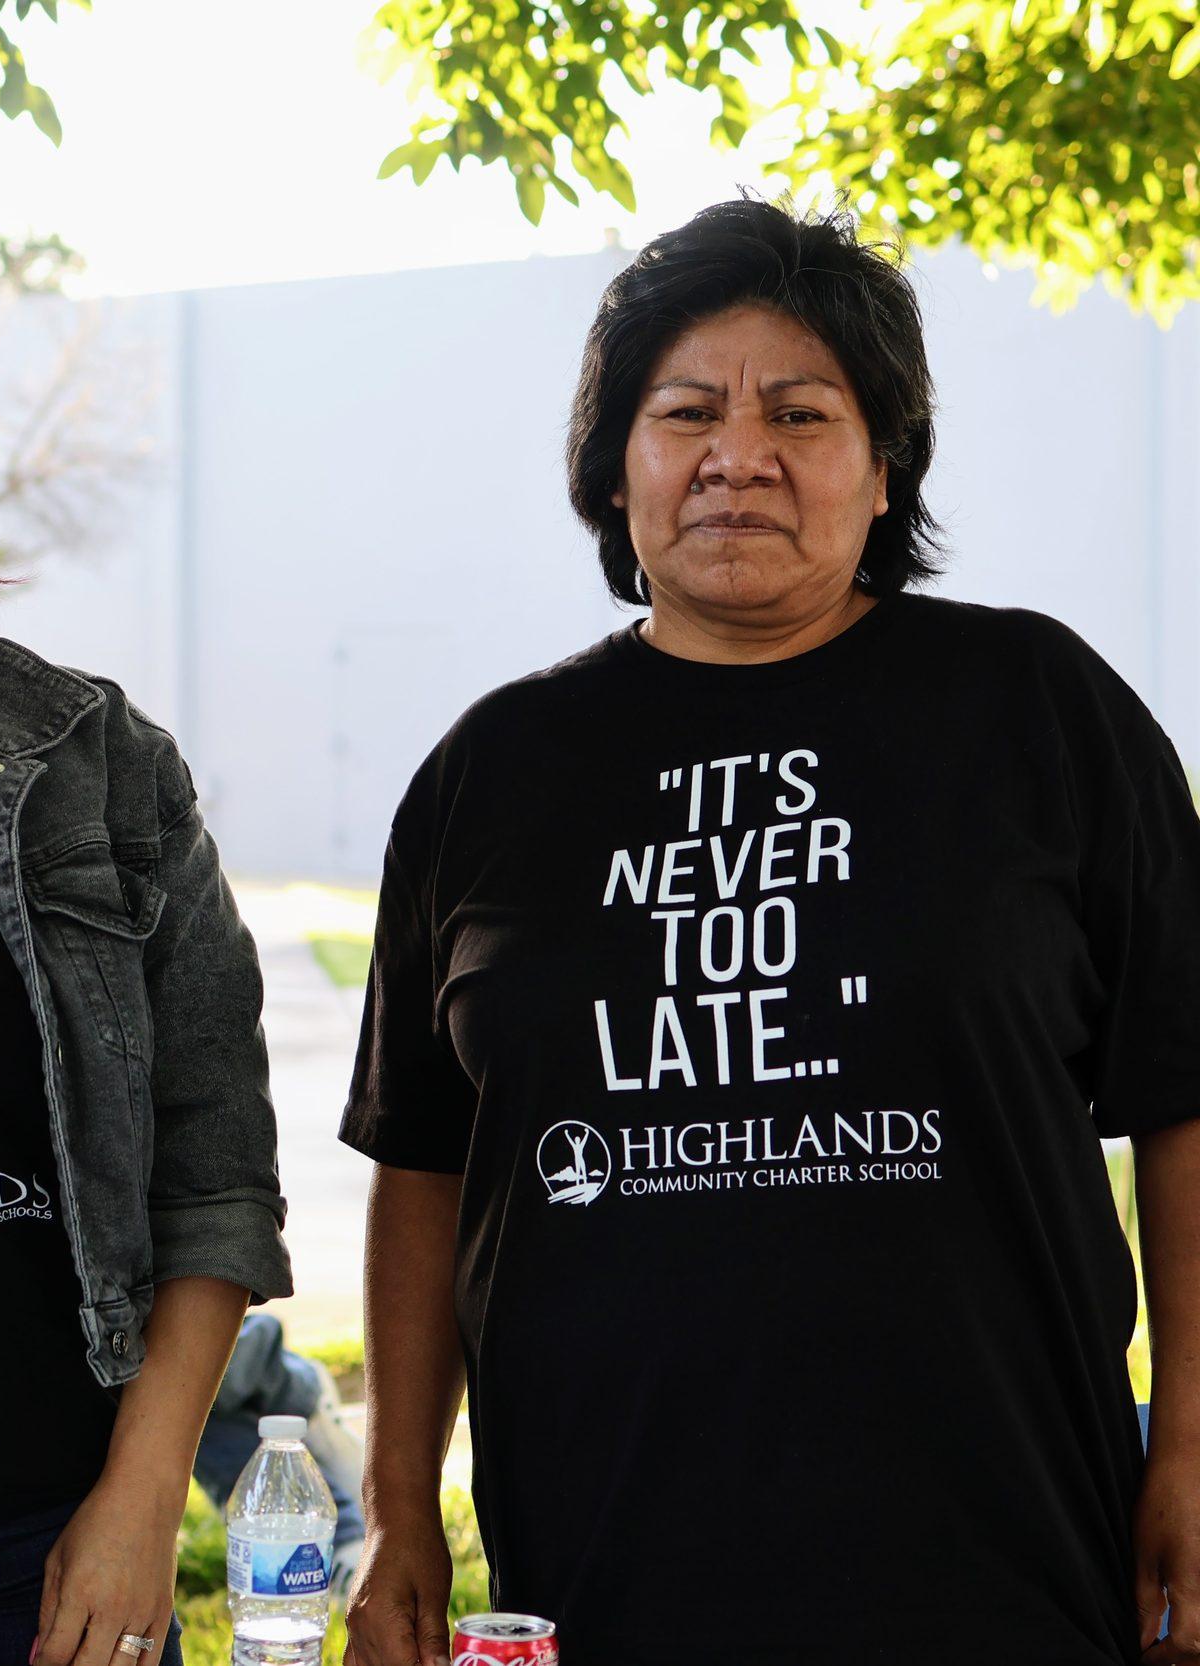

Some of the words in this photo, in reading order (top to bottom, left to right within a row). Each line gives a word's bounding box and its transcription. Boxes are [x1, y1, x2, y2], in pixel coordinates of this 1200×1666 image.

[659, 749, 819, 832] "IT'S
[603, 817, 852, 906] NEVER
[651, 896, 797, 986] TOO
[619, 1110, 942, 1170] HIGHLANDS
[620, 1170, 748, 1195] COMMUNITY
[753, 1165, 852, 1187] CHARTER
[858, 1162, 943, 1181] SCHOOL
[282, 1569, 326, 1586] WATER
